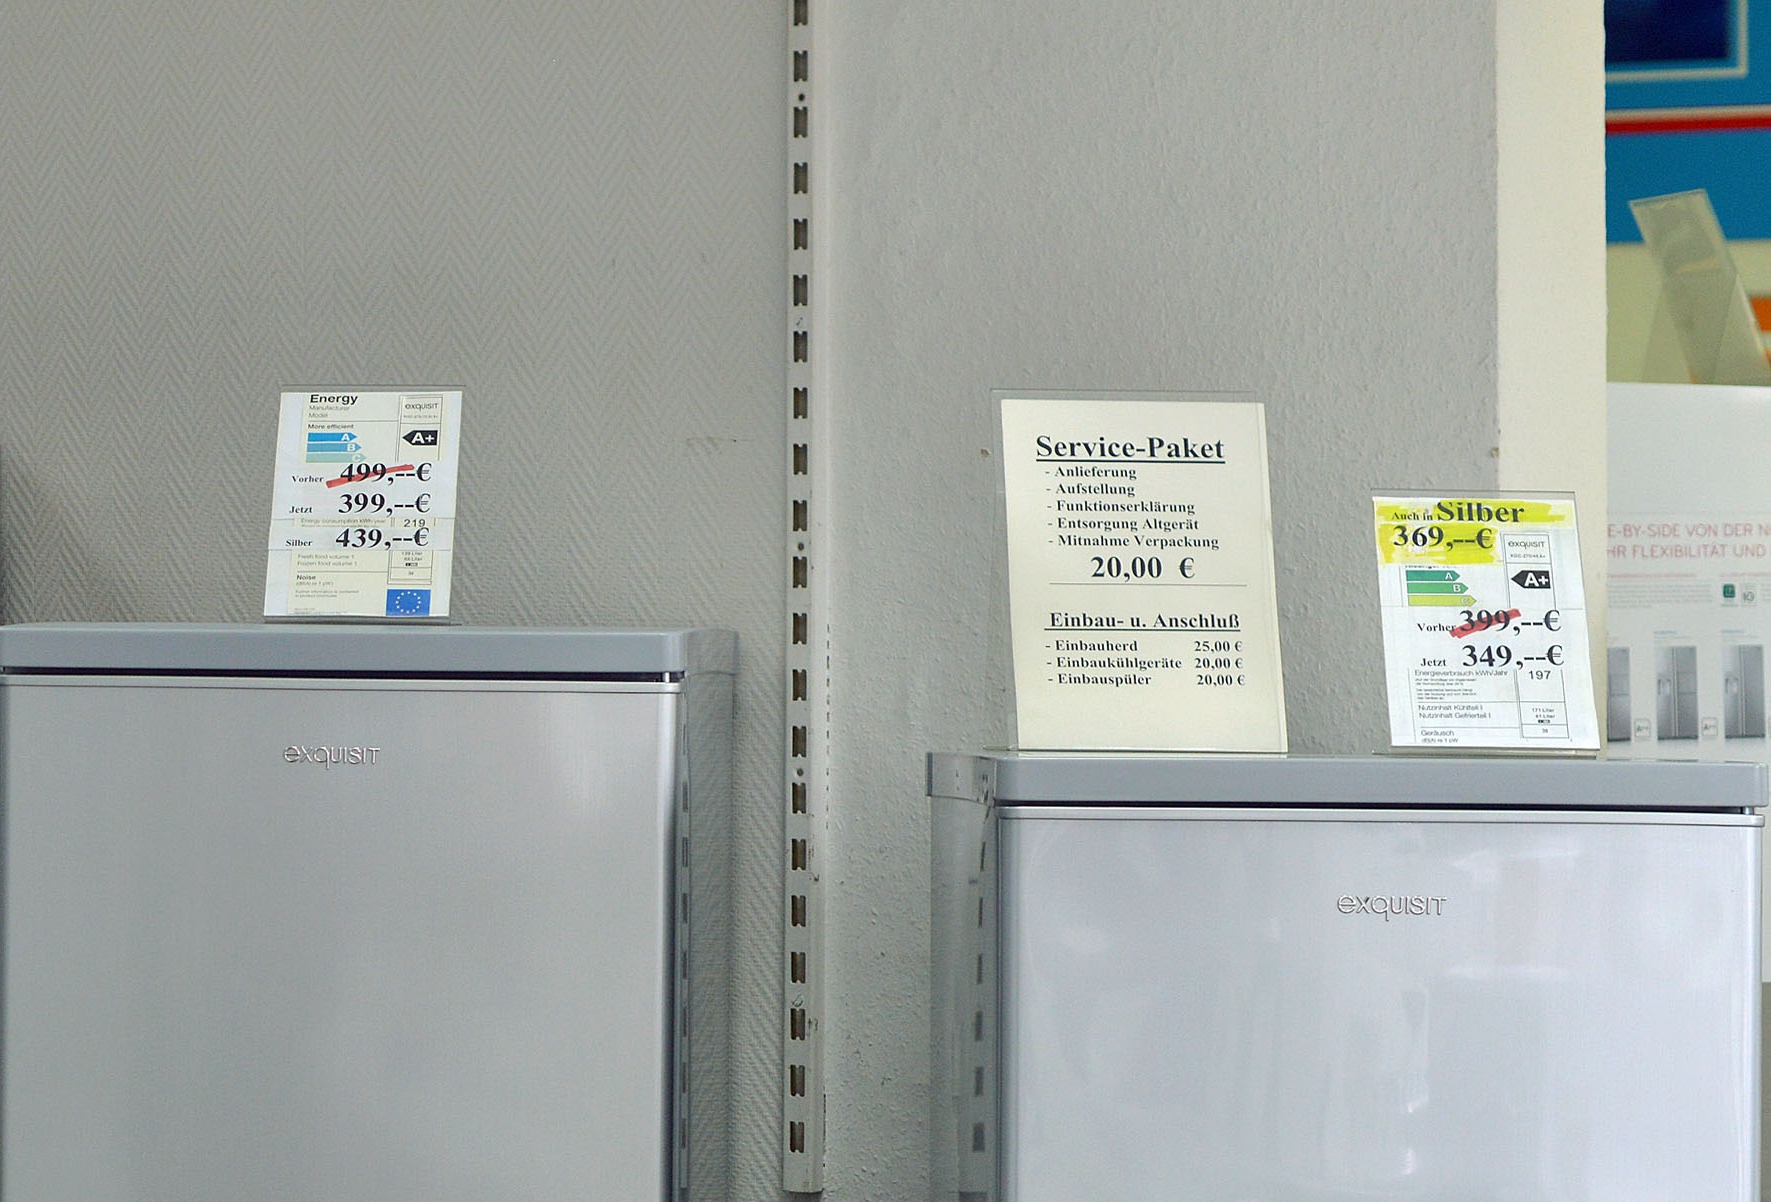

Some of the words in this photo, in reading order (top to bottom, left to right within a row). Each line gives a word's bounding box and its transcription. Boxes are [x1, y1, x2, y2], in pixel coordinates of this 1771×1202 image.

[310, 394, 358, 404] Energy
[412, 433, 434, 444] A+
[1036, 435, 1225, 459] Service-Paket
[1055, 467, 1137, 480] Anlieferung
[1056, 484, 1135, 496] Aufstellung
[289, 506, 313, 514] Jetzt
[1057, 500, 1195, 515] Funktionserklärung
[1392, 512, 1419, 521] Auch
[1423, 511, 1433, 521] in
[1437, 501, 1525, 523] Silber
[404, 519, 426, 527] 219
[1058, 518, 1138, 530] Entsorgung
[1142, 518, 1199, 532] Altgerät
[1686, 523, 1718, 537] VON
[1724, 523, 1753, 536] DER
[1058, 535, 1129, 547] Mitnahme
[1134, 535, 1219, 550] Verpackung
[1733, 544, 1766, 558] UND
[1091, 556, 1162, 582] 20,00
[1179, 557, 1196, 579] €
[1444, 572, 1453, 580] A
[1525, 573, 1549, 586] A+
[1453, 584, 1461, 593] B
[1050, 612, 1124, 628] Einbau-
[1131, 615, 1146, 628] u.
[1153, 613, 1239, 629] Anschluß
[1417, 623, 1456, 632] Vorher
[1055, 640, 1138, 651] Einbauherd
[1194, 641, 1230, 653] 25,00
[1234, 641, 1243, 652] €
[1057, 657, 1182, 671] Einbaukühlgeräte
[1195, 658, 1231, 670] 20,00
[1235, 658, 1243, 669] €
[1421, 658, 1447, 667] Jetzt
[1058, 673, 1152, 687] Einbauspüler
[1197, 675, 1233, 687] 20,00
[1237, 675, 1246, 686] €
[1529, 670, 1551, 680] 197
